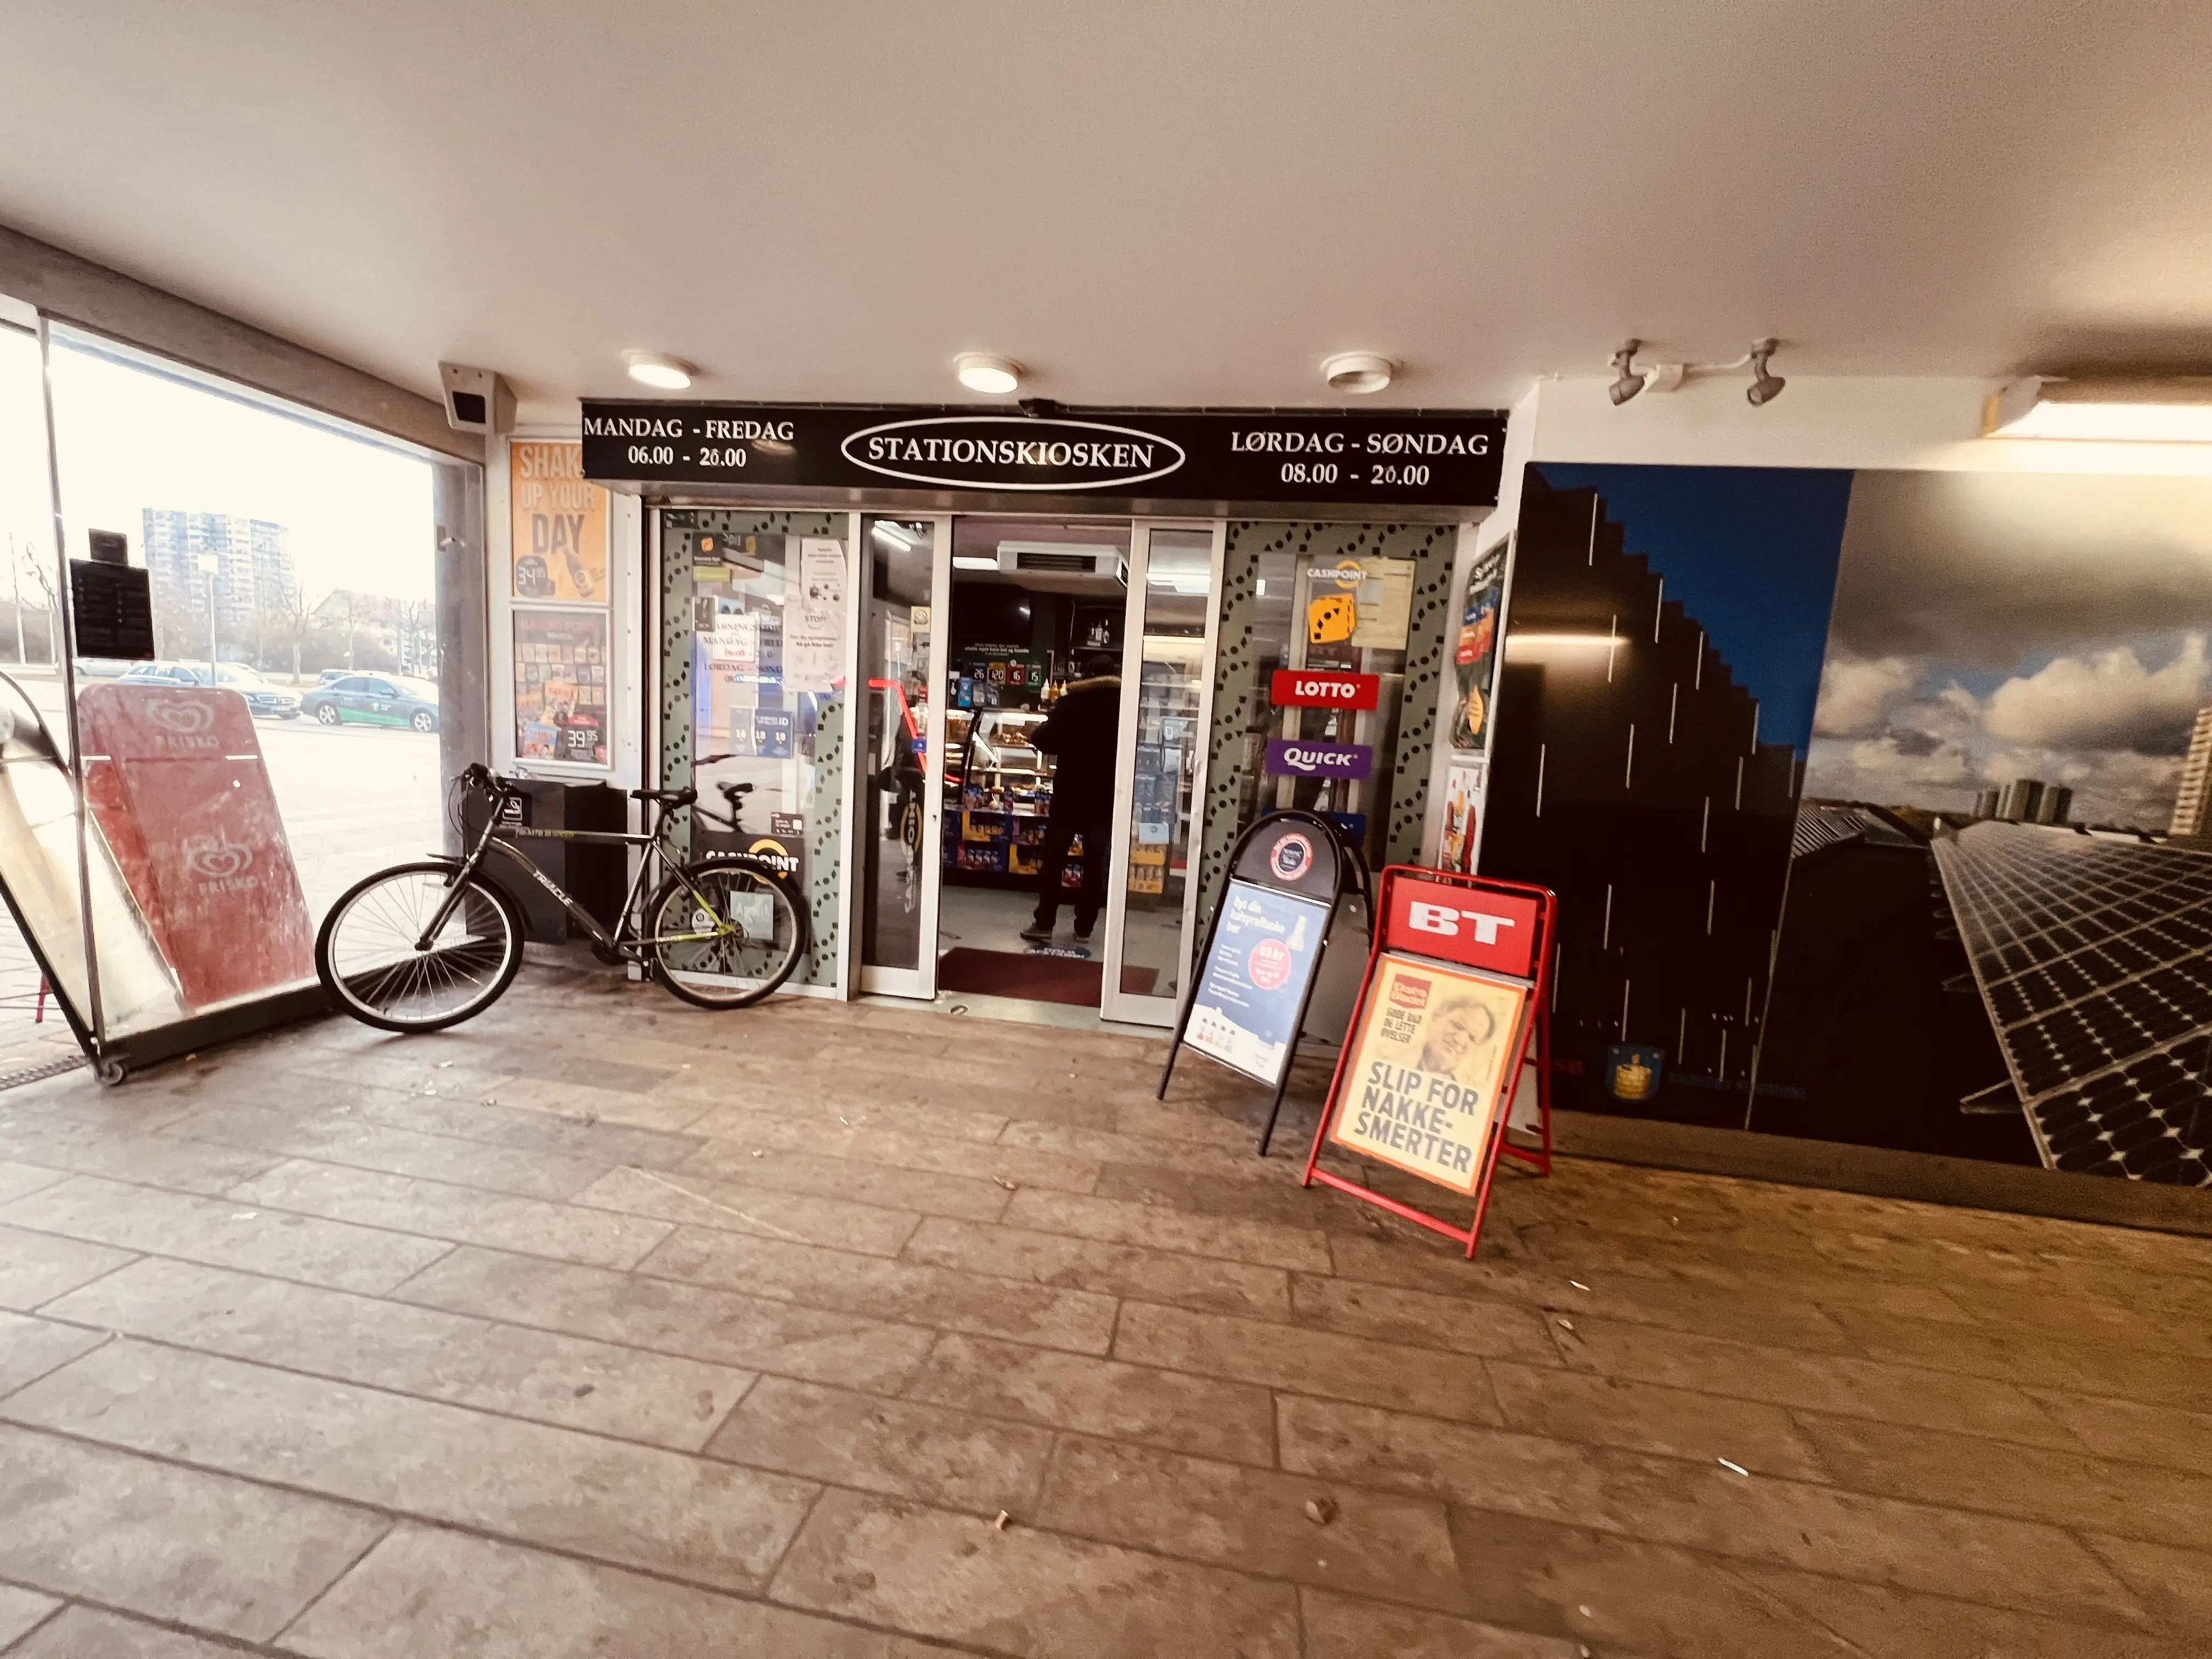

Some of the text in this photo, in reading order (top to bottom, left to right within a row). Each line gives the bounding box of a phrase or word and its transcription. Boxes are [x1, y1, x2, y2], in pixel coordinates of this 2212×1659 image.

[584, 418, 682, 438] MANDAG
[705, 420, 794, 441] FREDAG
[1231, 431, 1345, 453] LØRDAG
[1367, 432, 1489, 455] SØNDAG
[520, 445, 583, 478] SHAK
[628, 445, 673, 465] 06.00
[869, 437, 1154, 469] STATIONSKIOSKEN
[1281, 463, 1338, 484] 08.00
[1370, 464, 1430, 486] 20.00
[522, 483, 596, 512] UP YOUR
[532, 513, 585, 555] DAY
[1307, 568, 1368, 580] CASHPOINT
[1295, 680, 1356, 698] LOTTO
[568, 730, 585, 748] 39
[1409, 900, 1516, 946] BT
[1368, 1061, 1479, 1117] SLIP FOR
[1362, 1084, 1454, 1135] NAKKE-
[1354, 1111, 1472, 1174] SMERTER
